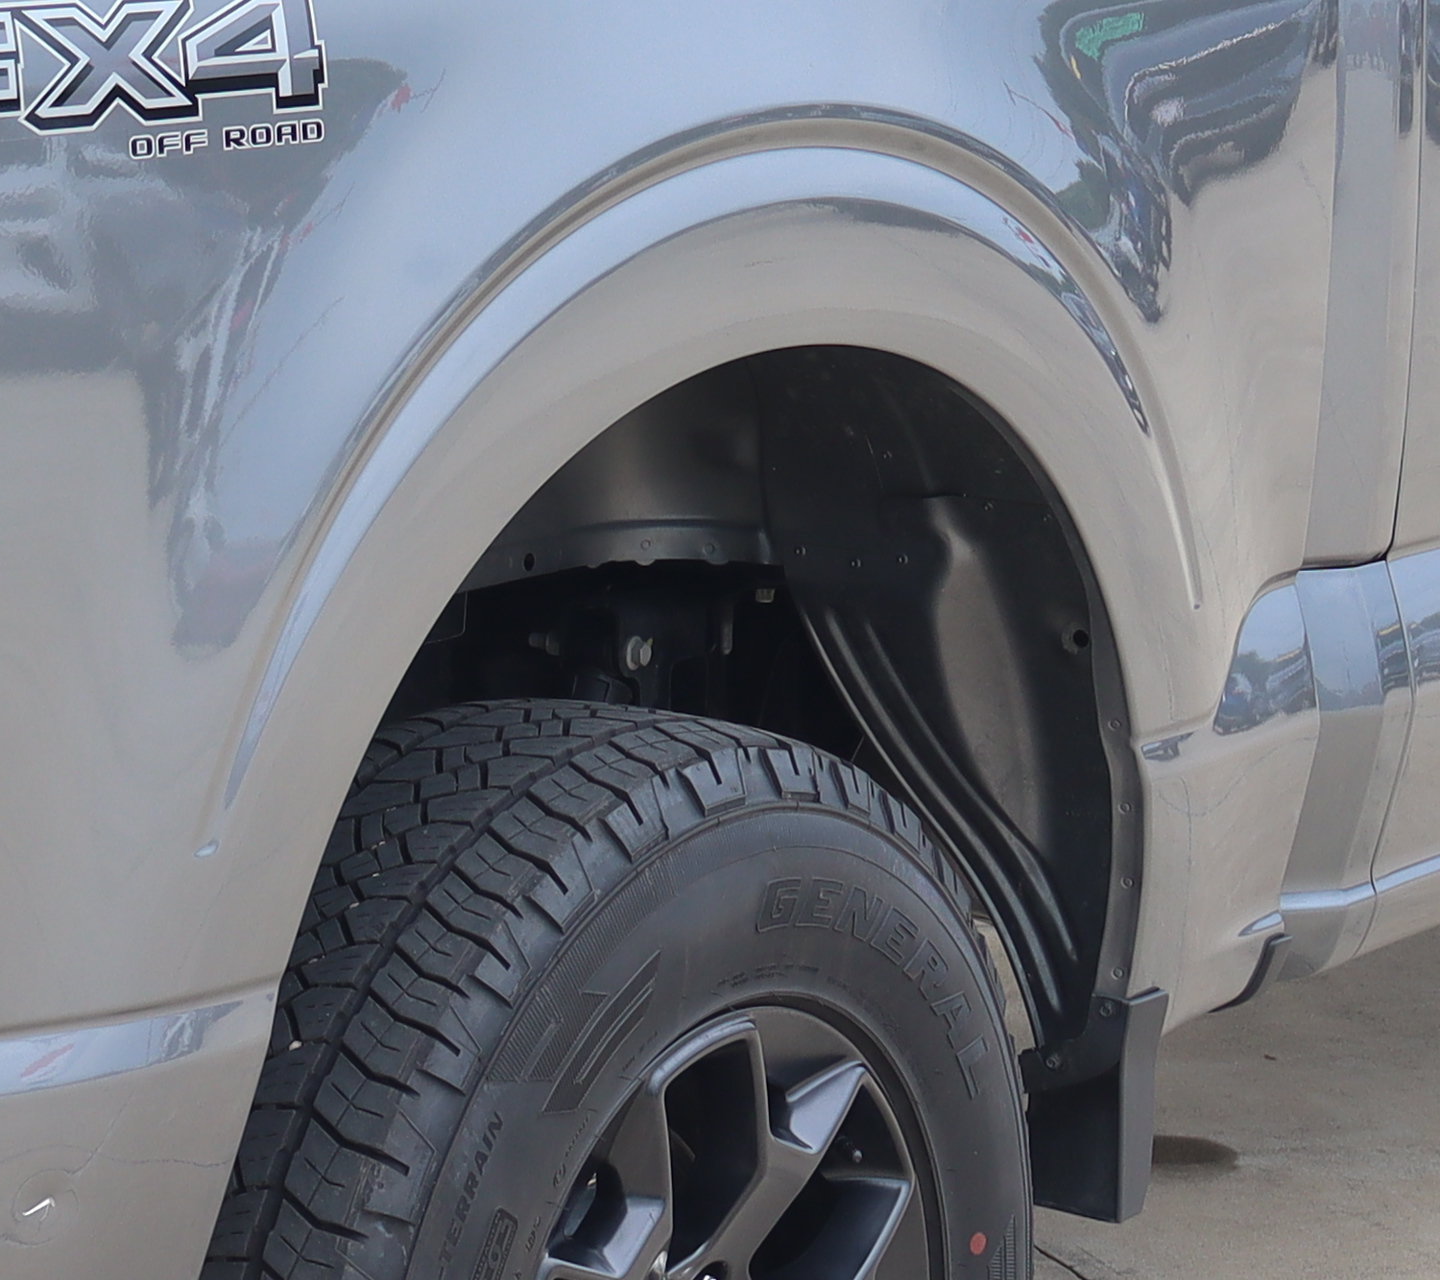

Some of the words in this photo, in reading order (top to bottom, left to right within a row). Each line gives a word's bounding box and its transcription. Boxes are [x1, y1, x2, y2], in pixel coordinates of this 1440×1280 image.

[129, 128, 209, 159] OFF
[223, 118, 325, 151] ROAD
[756, 876, 989, 1102] GENERAL
